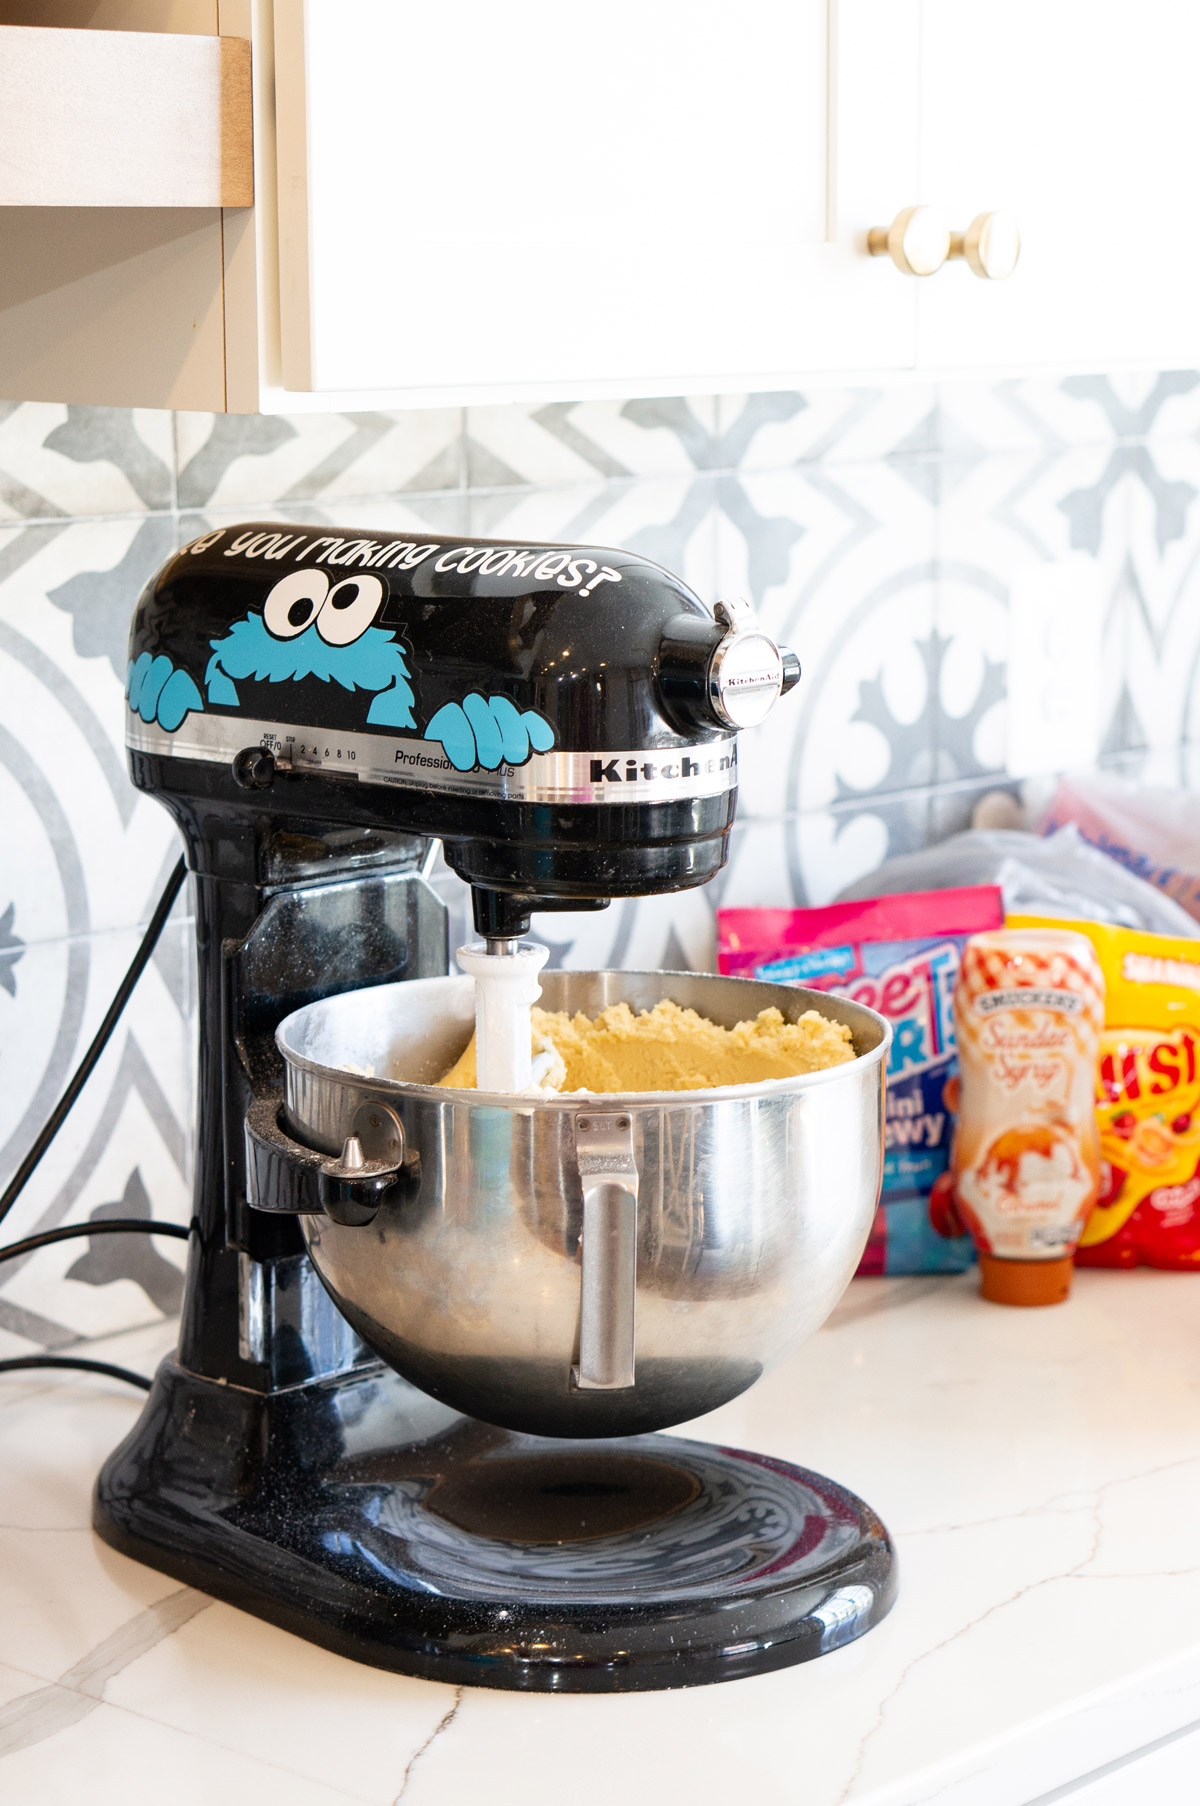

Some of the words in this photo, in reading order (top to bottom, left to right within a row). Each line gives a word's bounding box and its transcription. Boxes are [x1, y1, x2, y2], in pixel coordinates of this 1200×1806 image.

[223, 531, 307, 561] you
[315, 537, 441, 570] making
[434, 547, 623, 598] cookies?
[728, 673, 780, 687] KitchenAid
[263, 733, 277, 741] RESET
[300, 744, 306, 754] 2
[312, 746, 318, 756] 4
[324, 748, 330, 757] 6
[336, 749, 342, 759] 8
[347, 750, 356, 761] 10
[429, 782, 447, 791] before
[448, 785, 471, 795] inserting
[479, 789, 507, 799] removing
[984, 1020, 1068, 1048] Sundae
[993, 1052, 1061, 1090] Syrup
